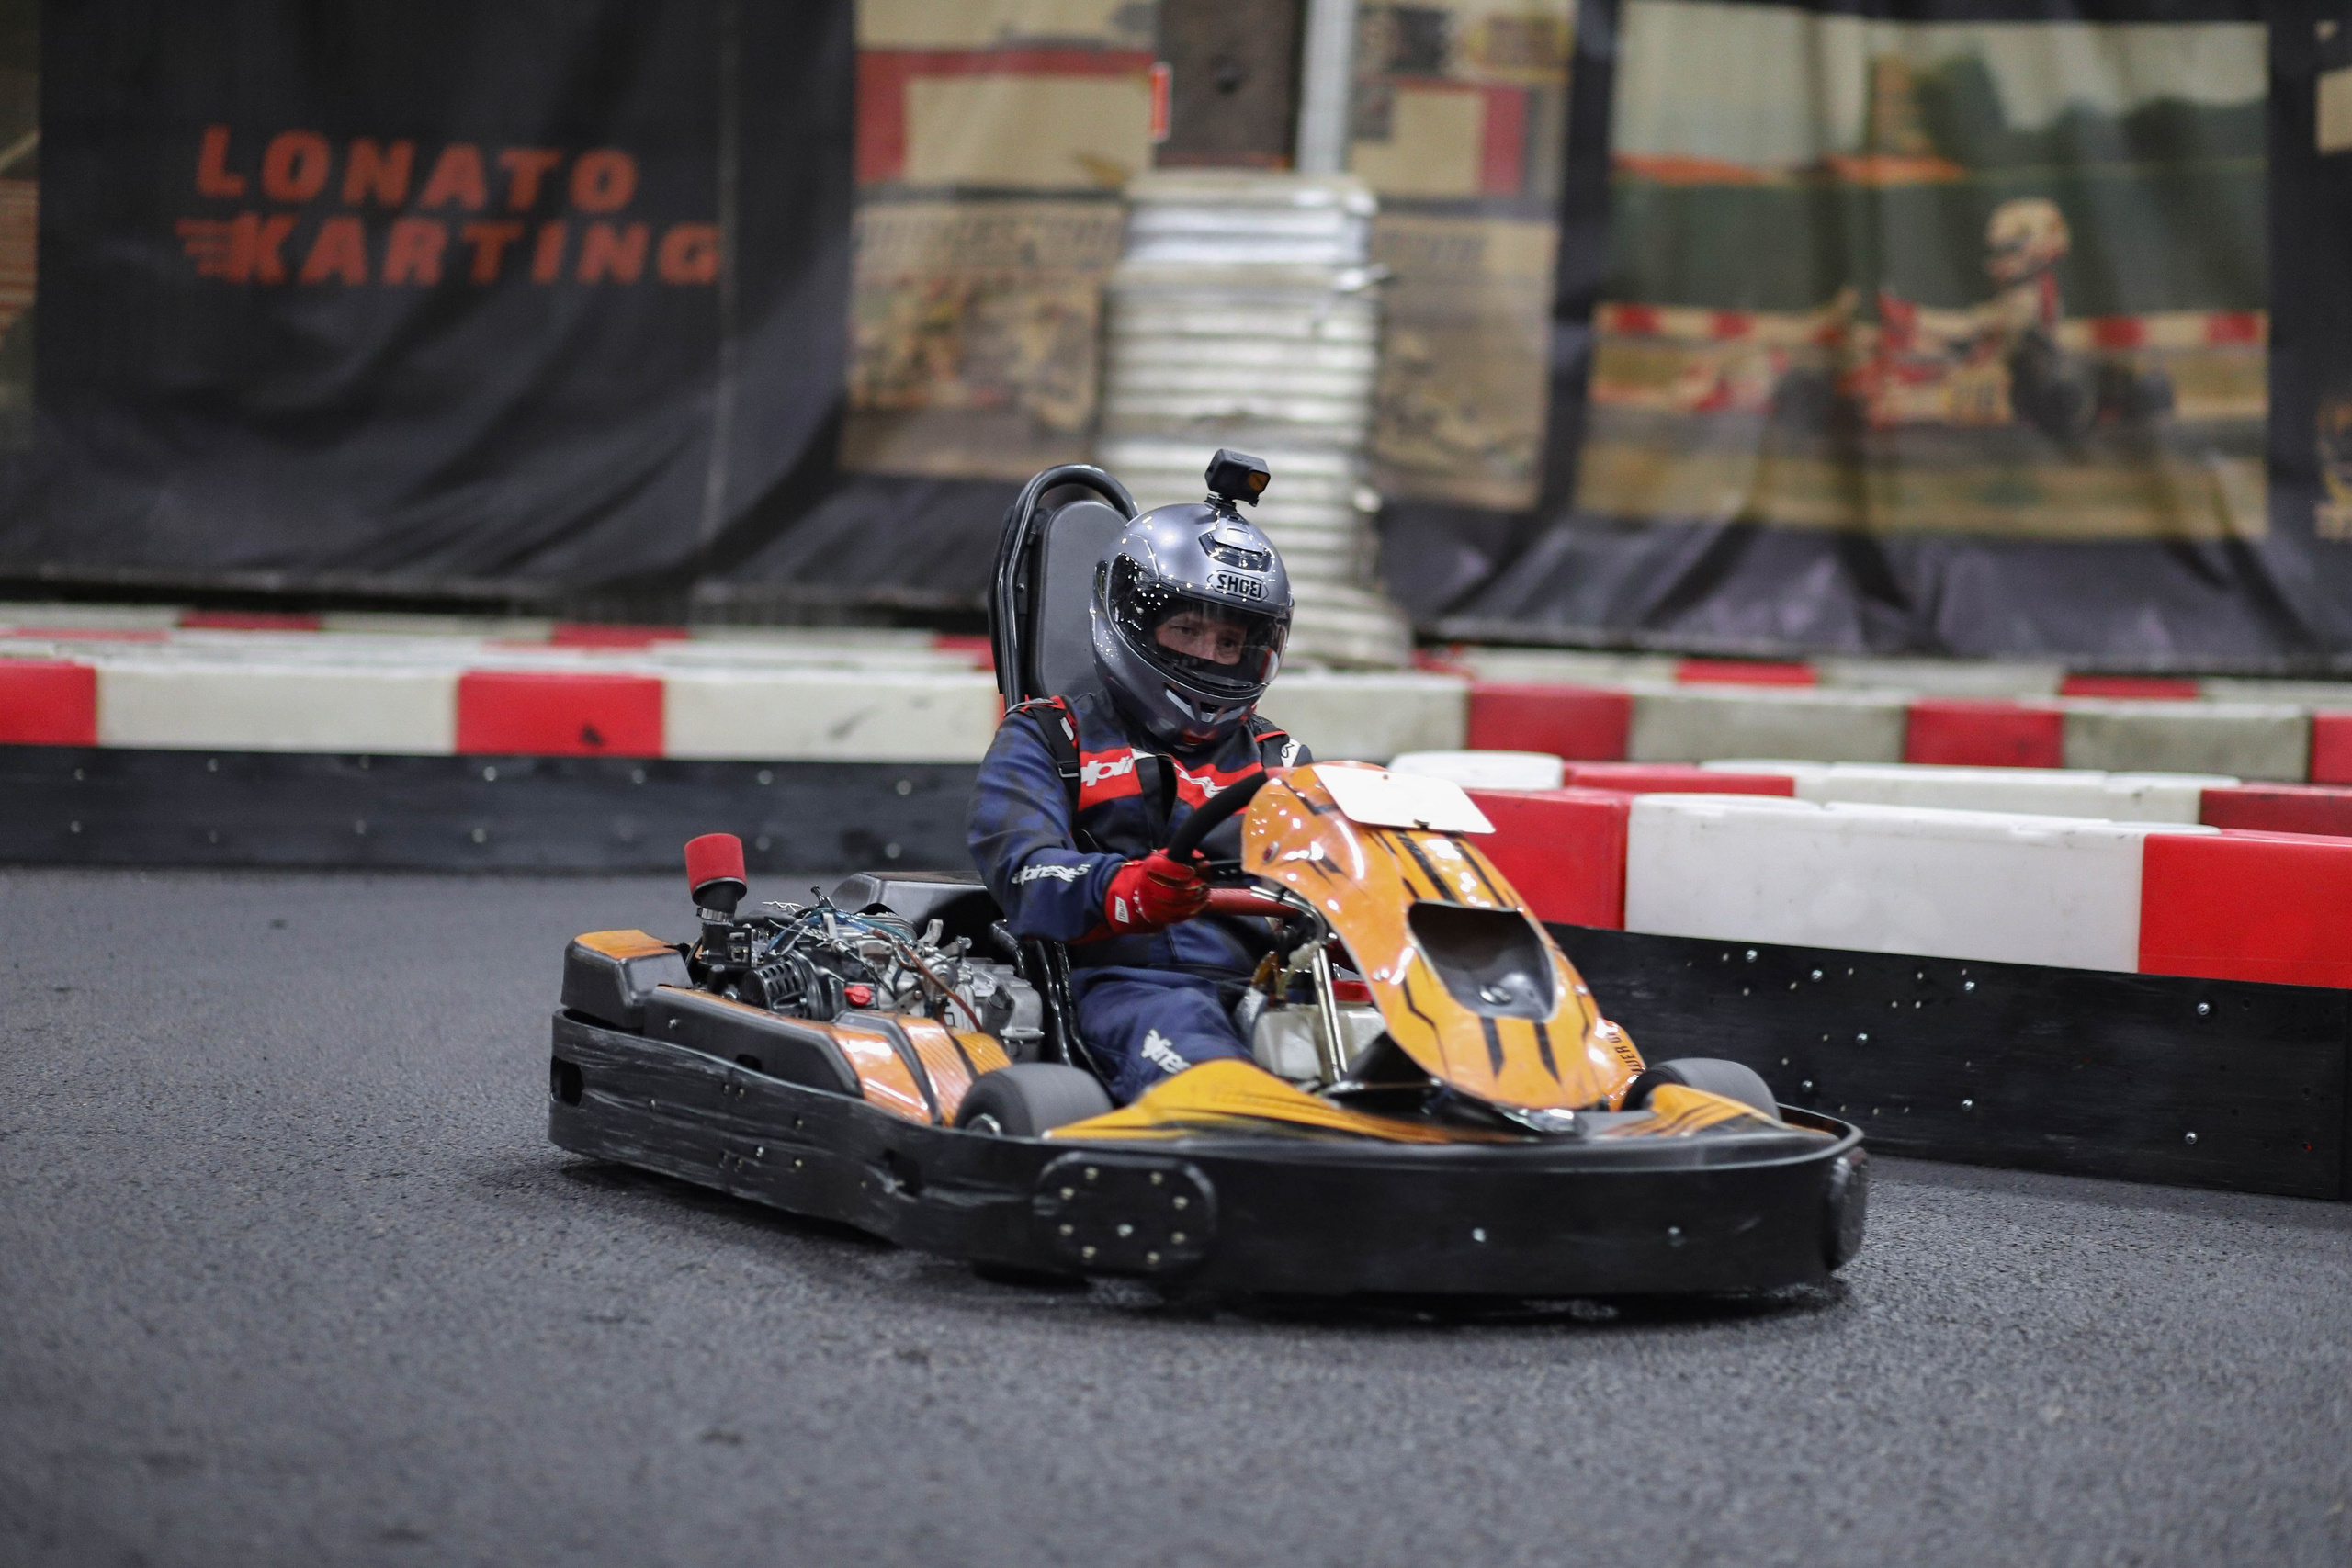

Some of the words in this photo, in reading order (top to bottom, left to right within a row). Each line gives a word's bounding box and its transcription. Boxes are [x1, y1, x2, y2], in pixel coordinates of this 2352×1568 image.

[195, 125, 639, 212] LONATO
[223, 212, 721, 286] KARTING
[1216, 573, 1262, 599] SHOEI
